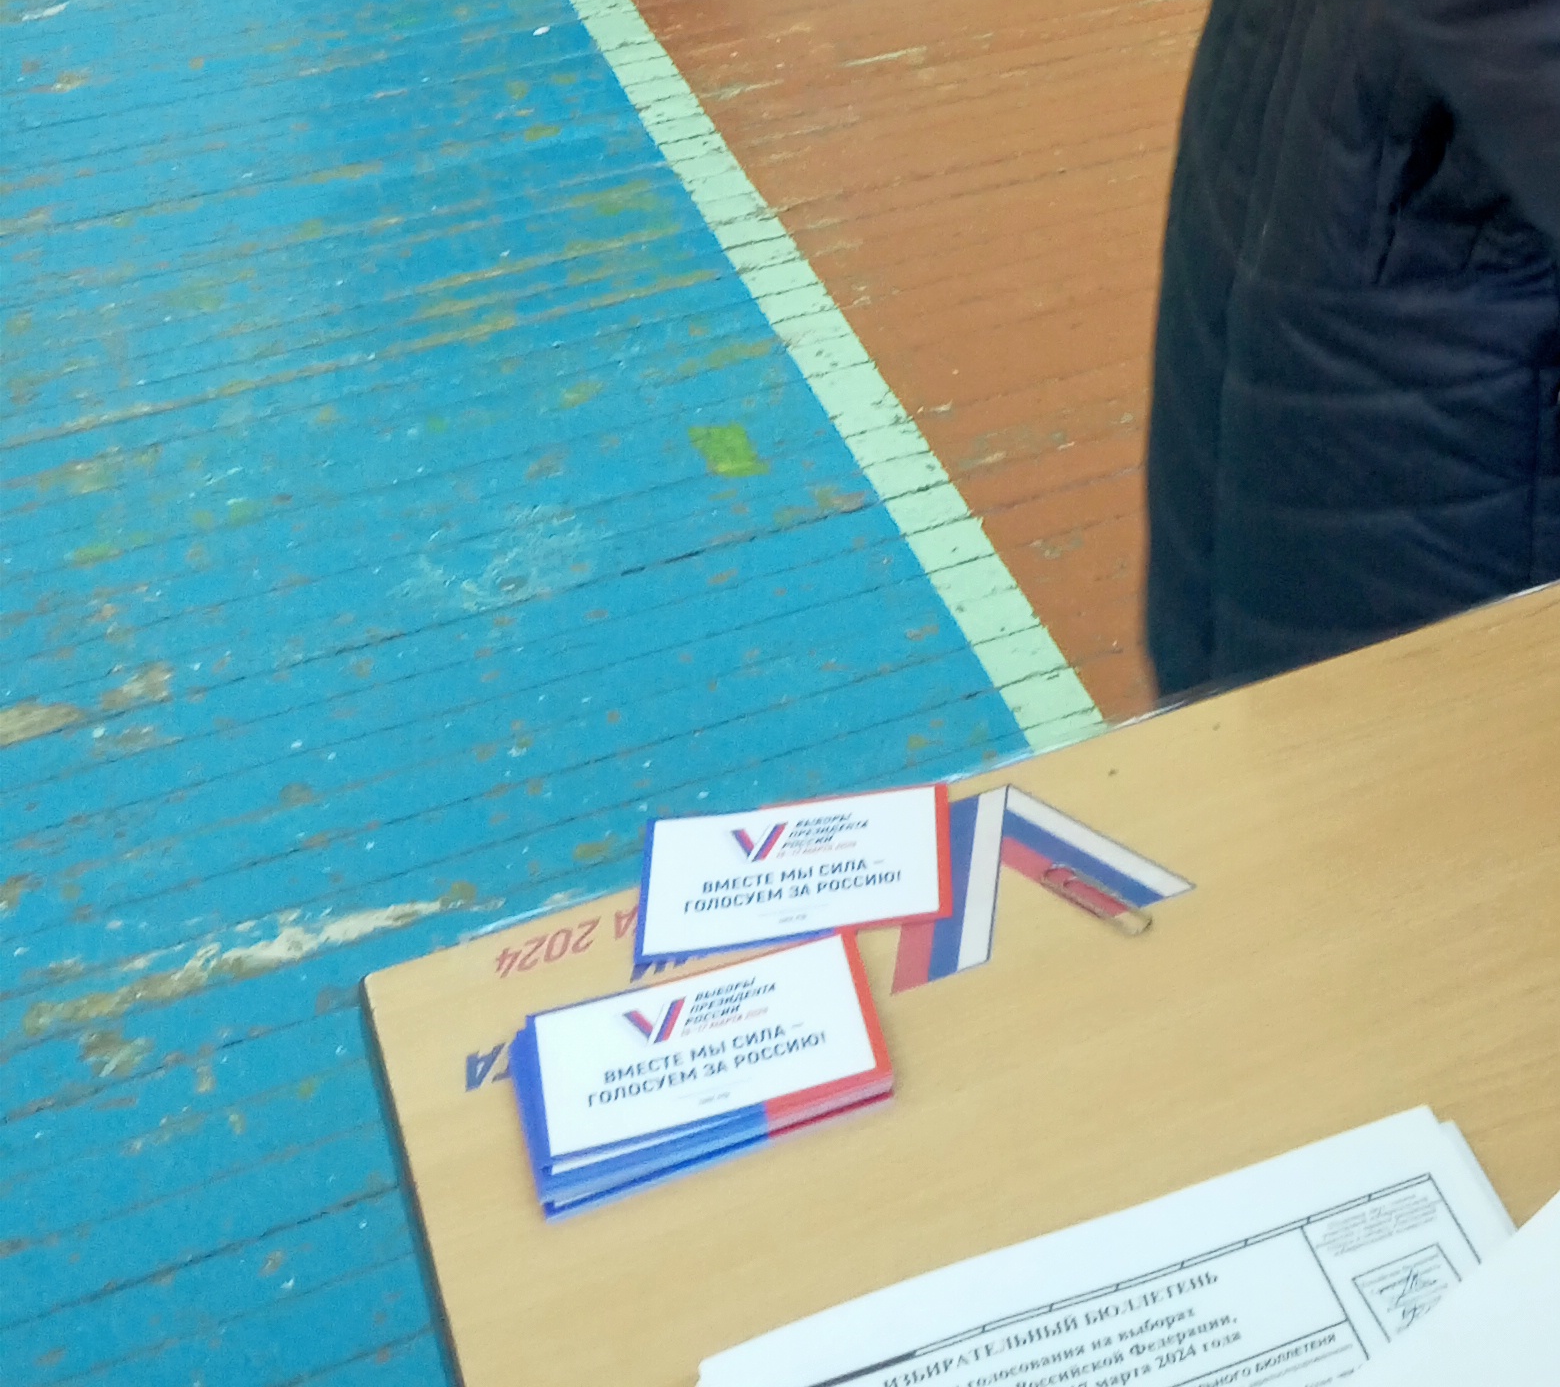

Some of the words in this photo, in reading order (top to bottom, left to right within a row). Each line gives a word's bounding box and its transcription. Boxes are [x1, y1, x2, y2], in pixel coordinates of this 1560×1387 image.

[684, 887, 783, 914] ГОЛОСУЕМ
[788, 883, 811, 899] ЗА
[816, 870, 902, 895] РОССИЮ!
[702, 872, 774, 894] ВМЕСТЕ
[780, 865, 813, 883] МЫ
[819, 858, 868, 875] СИЛА
[495, 915, 601, 978] 2024
[587, 1067, 698, 1108] ГОЛОСУЕМ
[703, 1060, 729, 1078] ЗА
[734, 1030, 827, 1069] РОССИЮ!
[603, 1052, 685, 1085] ВМЕСТЕ
[690, 1041, 726, 1061] МЫ
[732, 1024, 787, 1050] СИЛА
[883, 1313, 1079, 1387] ИЗБИРАТЕЛЬНЫЙ
[1084, 1271, 1219, 1326] БЮЛЛЕТЕНЬ
[967, 1344, 1085, 1387] голосования
[1091, 1335, 1113, 1351] на
[1117, 1307, 1196, 1342] выборах
[1095, 1362, 1152, 1387] марта
[1155, 1343, 1197, 1369] 2024
[1202, 1331, 1241, 1352] года
[1129, 1314, 1238, 1357] Федерации,
